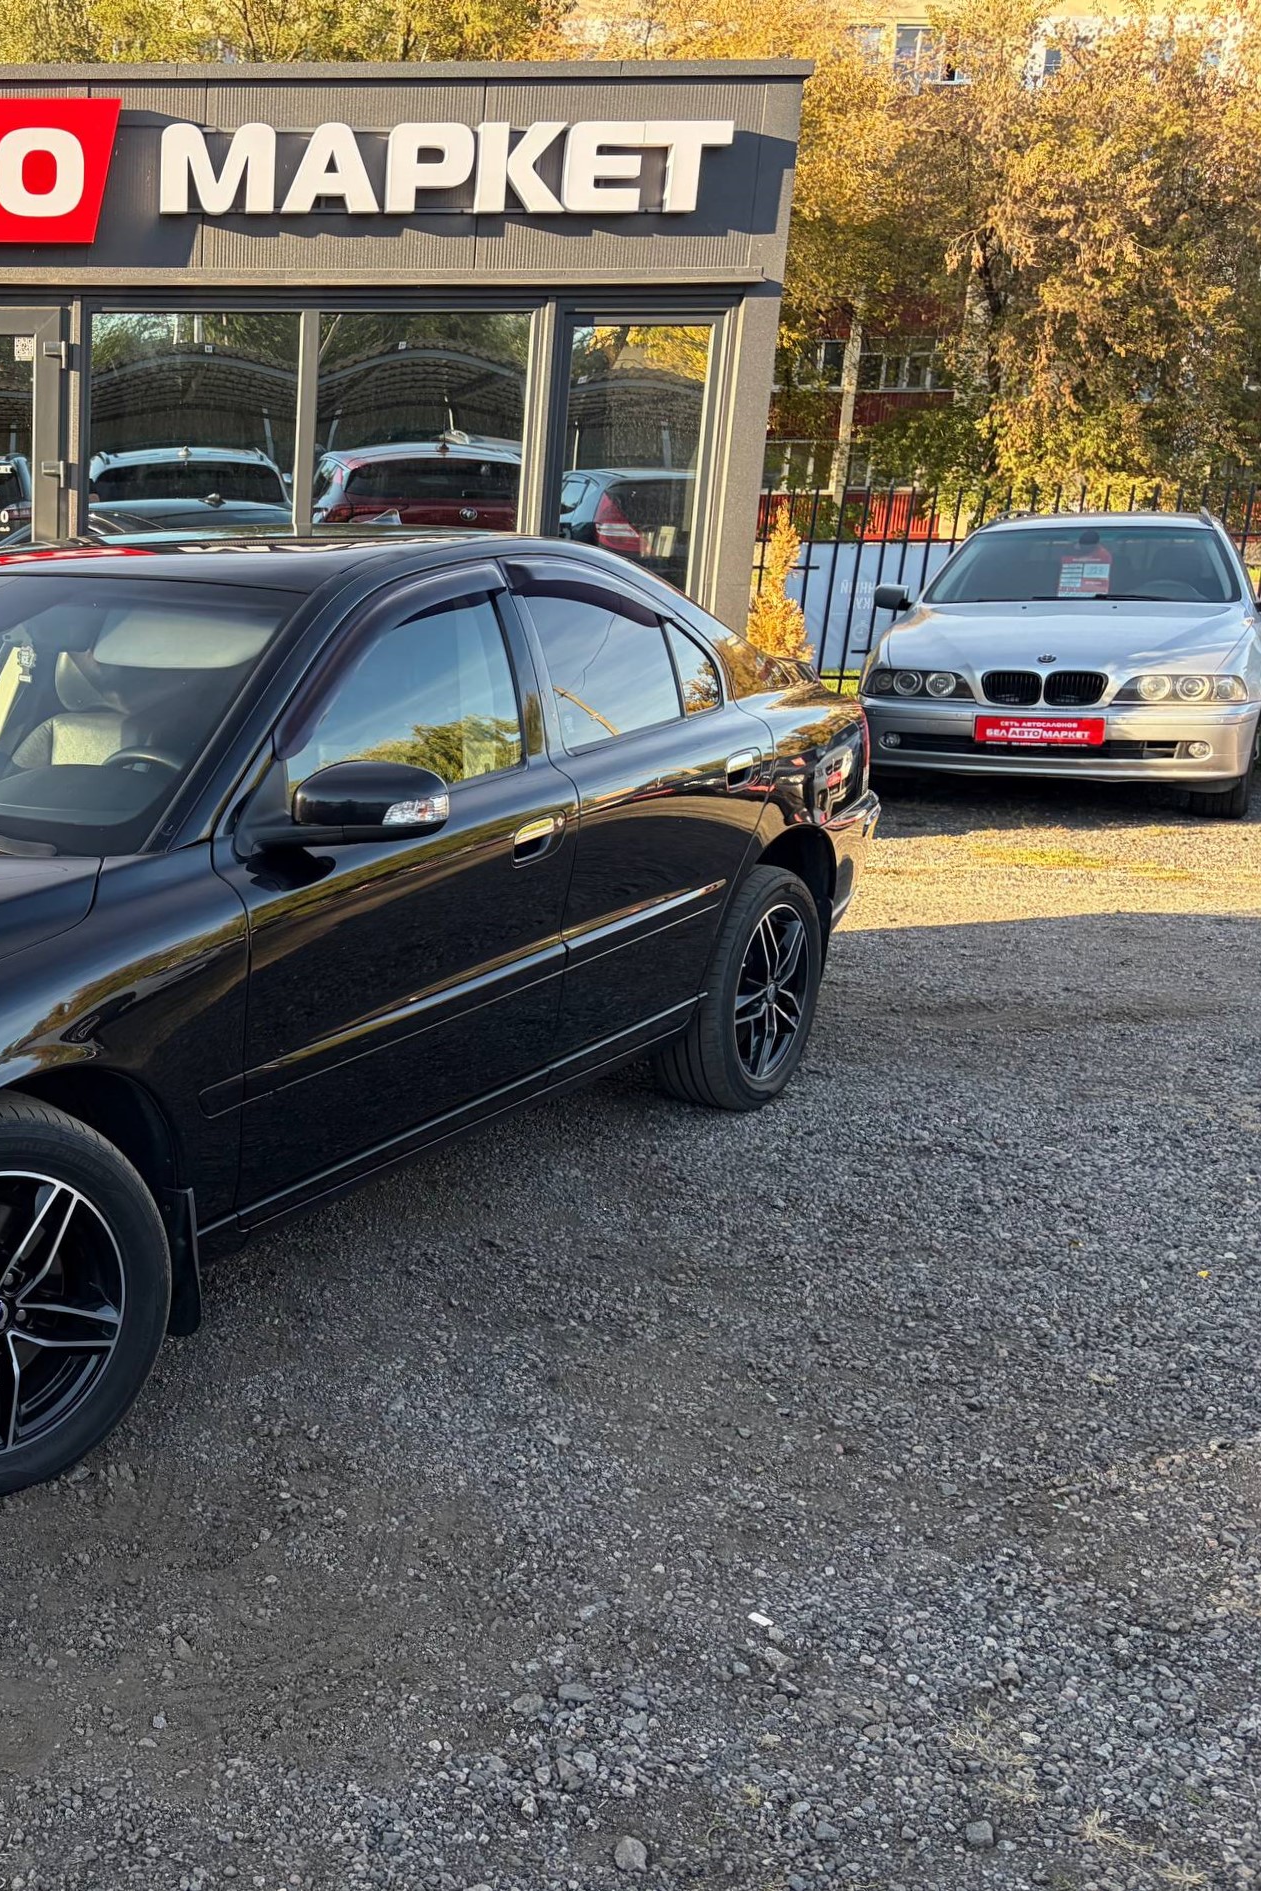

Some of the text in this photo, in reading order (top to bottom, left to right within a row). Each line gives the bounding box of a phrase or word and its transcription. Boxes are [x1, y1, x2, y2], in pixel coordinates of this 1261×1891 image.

[159, 120, 734, 215] МАРКЕТ
[986, 728, 1090, 739] БЕЛ АВТО МАРКЕТ
